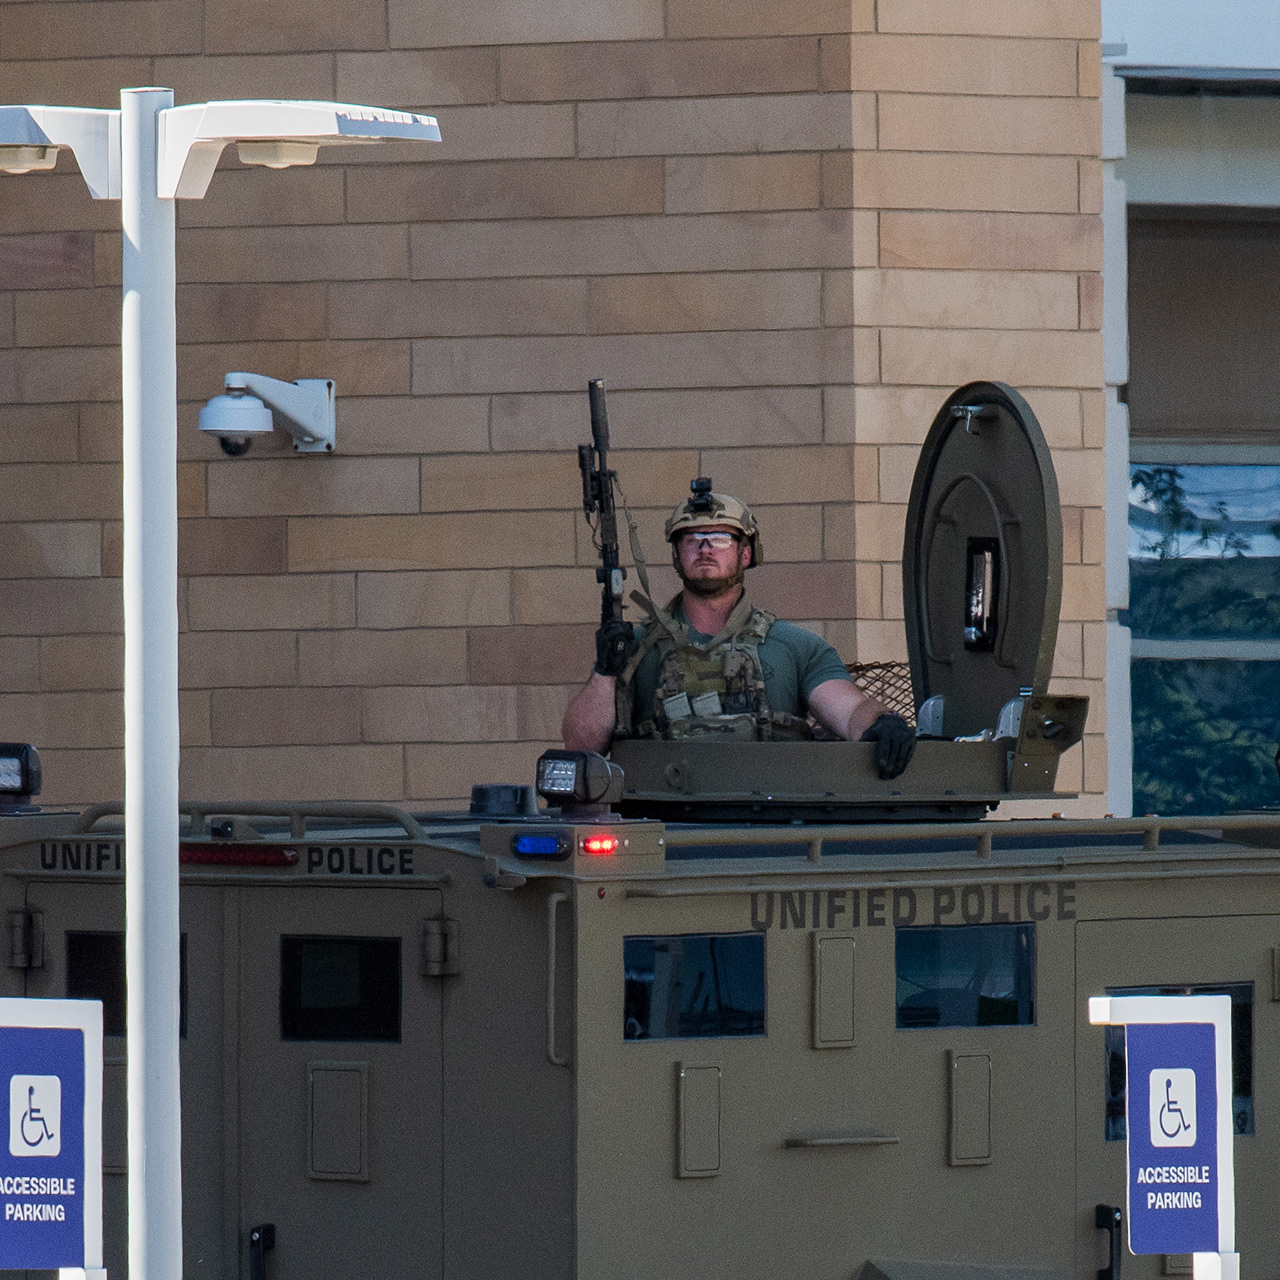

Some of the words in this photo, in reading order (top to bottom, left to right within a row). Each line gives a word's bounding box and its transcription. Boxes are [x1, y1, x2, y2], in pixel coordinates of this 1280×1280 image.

[40, 842, 124, 872] UNIFI
[307, 847, 415, 875] POLICE
[750, 887, 917, 931] UNIFIED
[932, 881, 1077, 924] POLICE
[1137, 1165, 1210, 1185] ACCESSIBLE
[1147, 1191, 1202, 1210] PARKING
[5, 1203, 66, 1222] PARKING
